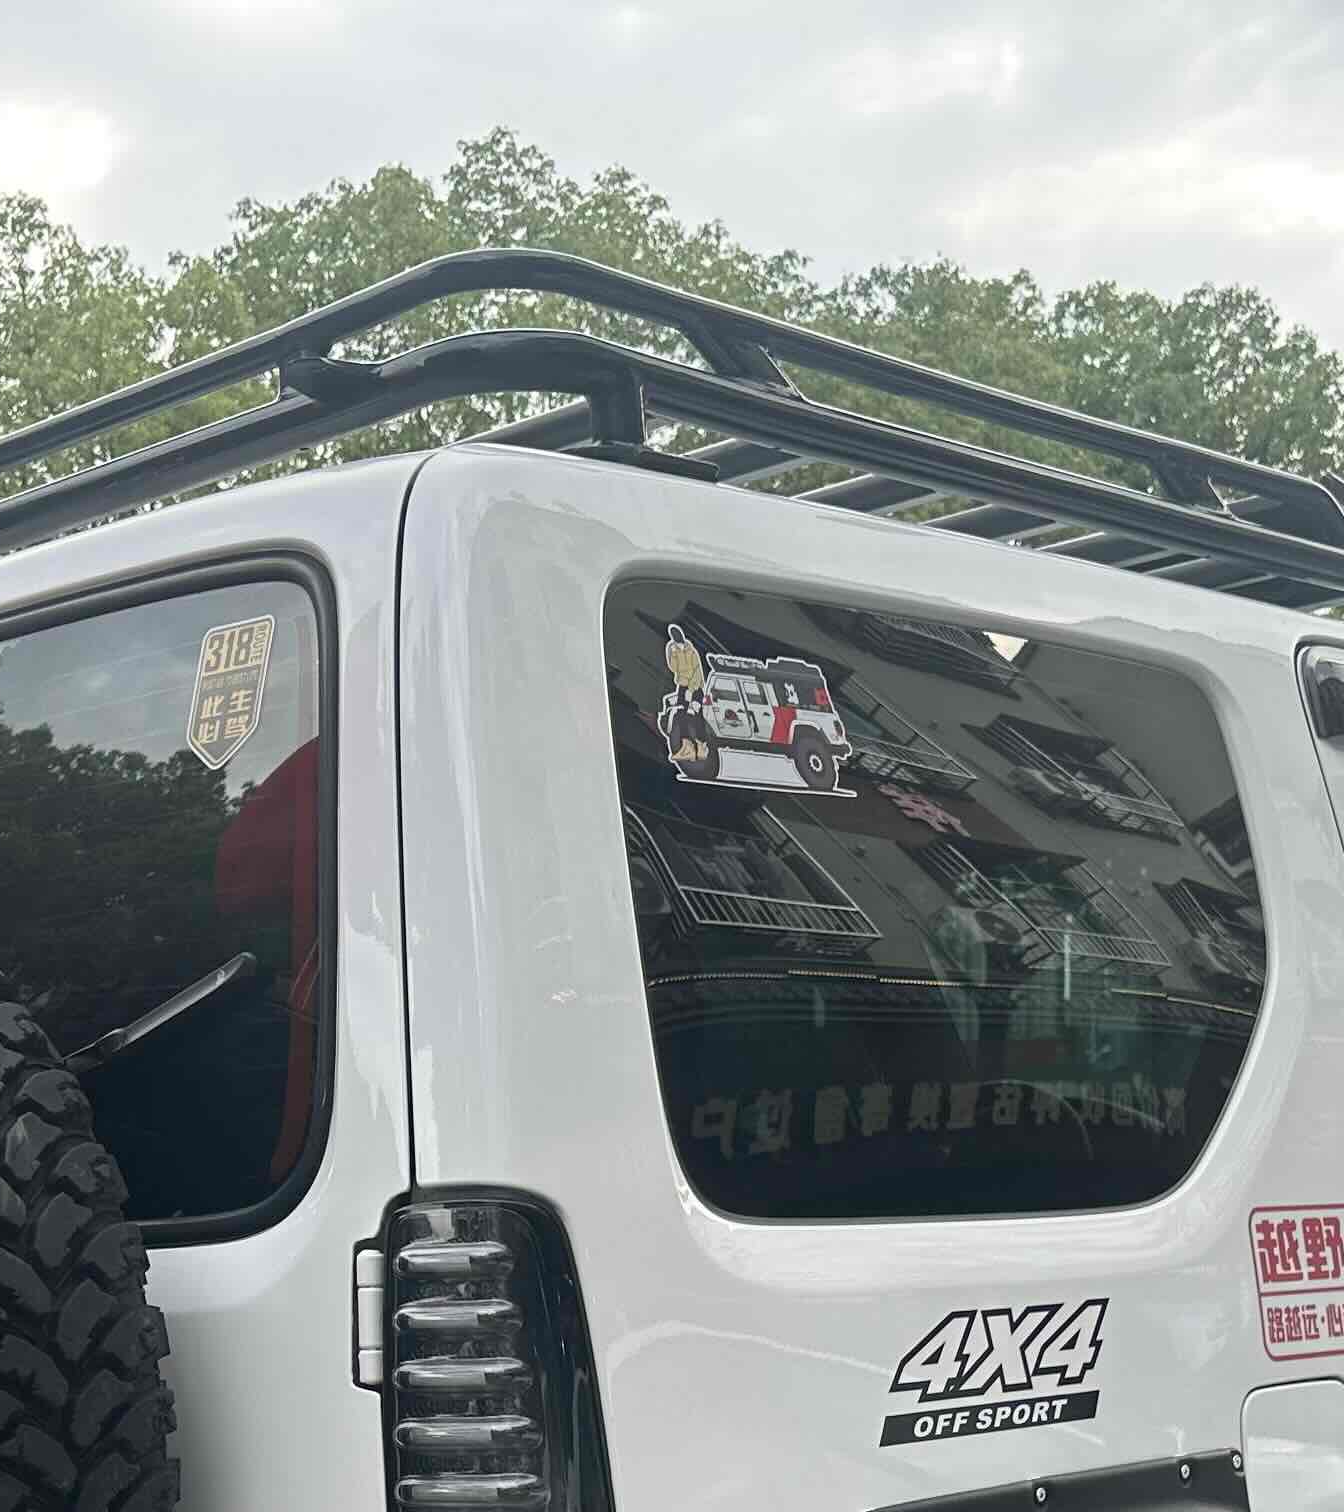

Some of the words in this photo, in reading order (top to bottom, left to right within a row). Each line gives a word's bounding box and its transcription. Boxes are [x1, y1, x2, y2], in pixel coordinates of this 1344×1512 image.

[206, 626, 254, 672] 318
[888, 1298, 1110, 1403] 4X4
[913, 1411, 970, 1438] OFF
[975, 1399, 1068, 1430] SPORT
